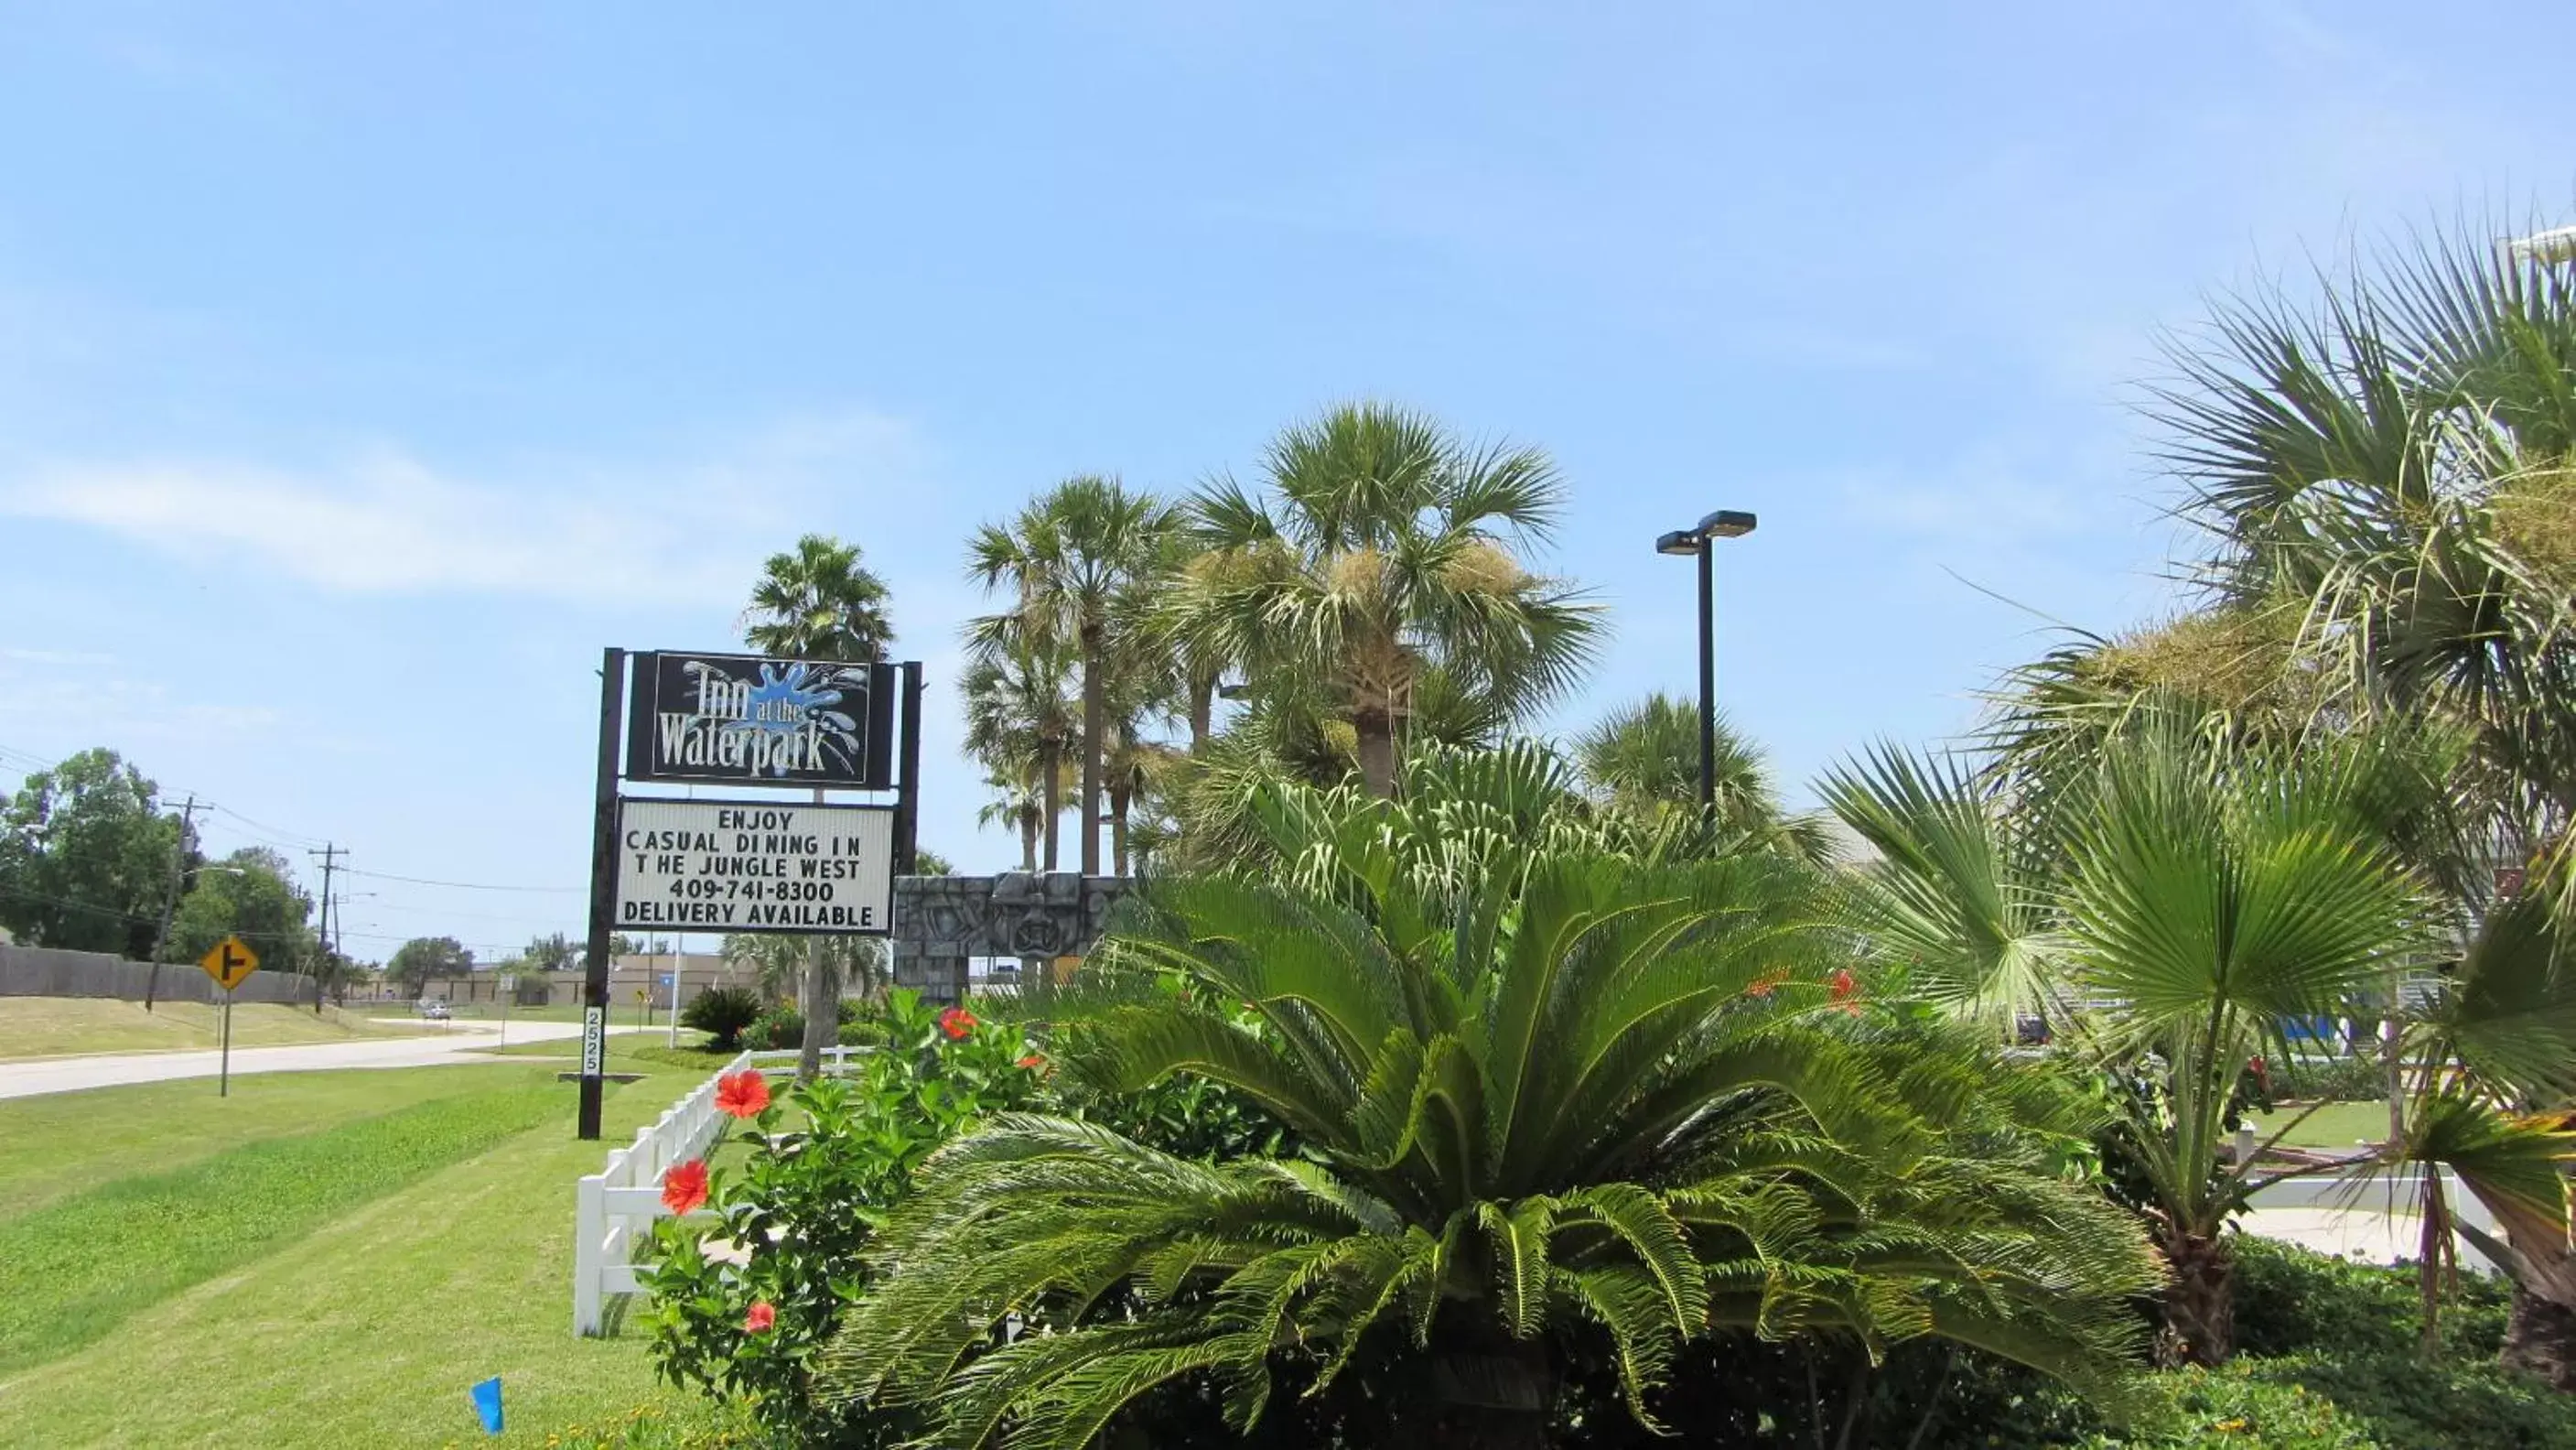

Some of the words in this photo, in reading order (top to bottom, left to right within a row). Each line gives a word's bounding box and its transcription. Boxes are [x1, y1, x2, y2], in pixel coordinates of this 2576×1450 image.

[697, 668, 750, 720] Inn
[756, 698, 772, 720] at
[777, 697, 802, 722] the
[659, 712, 825, 777] Waterpark
[718, 810, 793, 830] ENJOY
[626, 830, 720, 852] CASUAL
[736, 833, 818, 855] DINING
[832, 837, 860, 856] IN
[635, 854, 684, 874] THE
[698, 857, 787, 878] JUNGLE
[800, 859, 860, 879] WEST
[669, 879, 834, 902] 409-741-8300
[624, 901, 736, 923] DELIVERY
[747, 904, 872, 926] AVAILABLE
[587, 1012, 598, 1070] 2525
